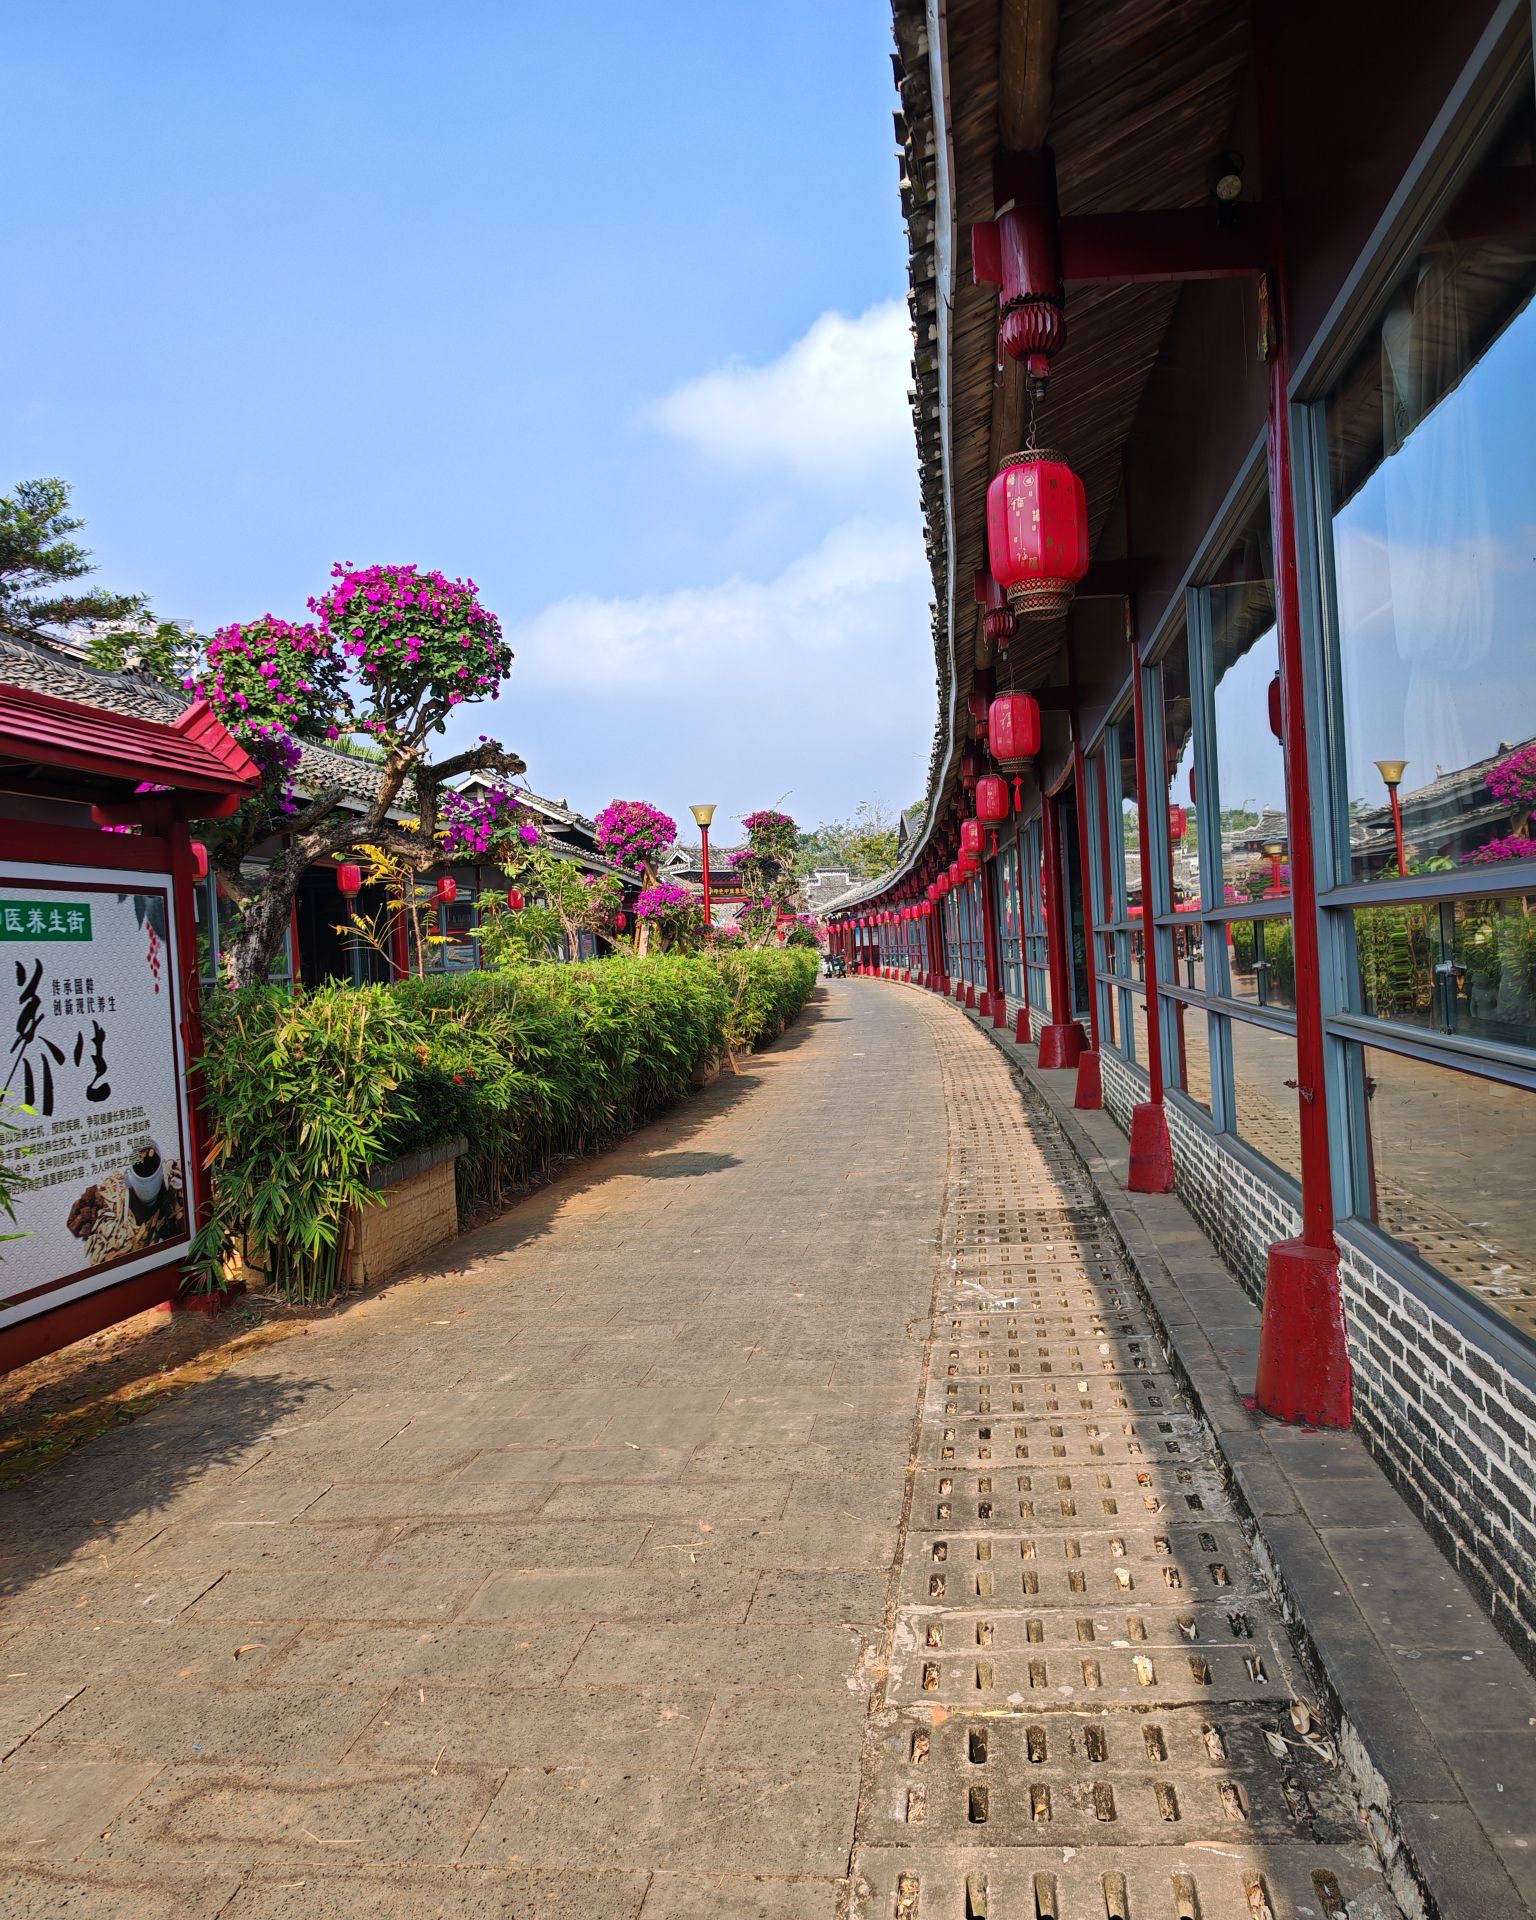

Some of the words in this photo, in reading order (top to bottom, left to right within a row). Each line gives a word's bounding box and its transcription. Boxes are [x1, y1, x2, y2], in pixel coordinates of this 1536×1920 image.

[0, 907, 86, 934] 医养生街
[52, 978, 94, 996] 传承国粹
[53, 996, 116, 1016] 创新现代养生
